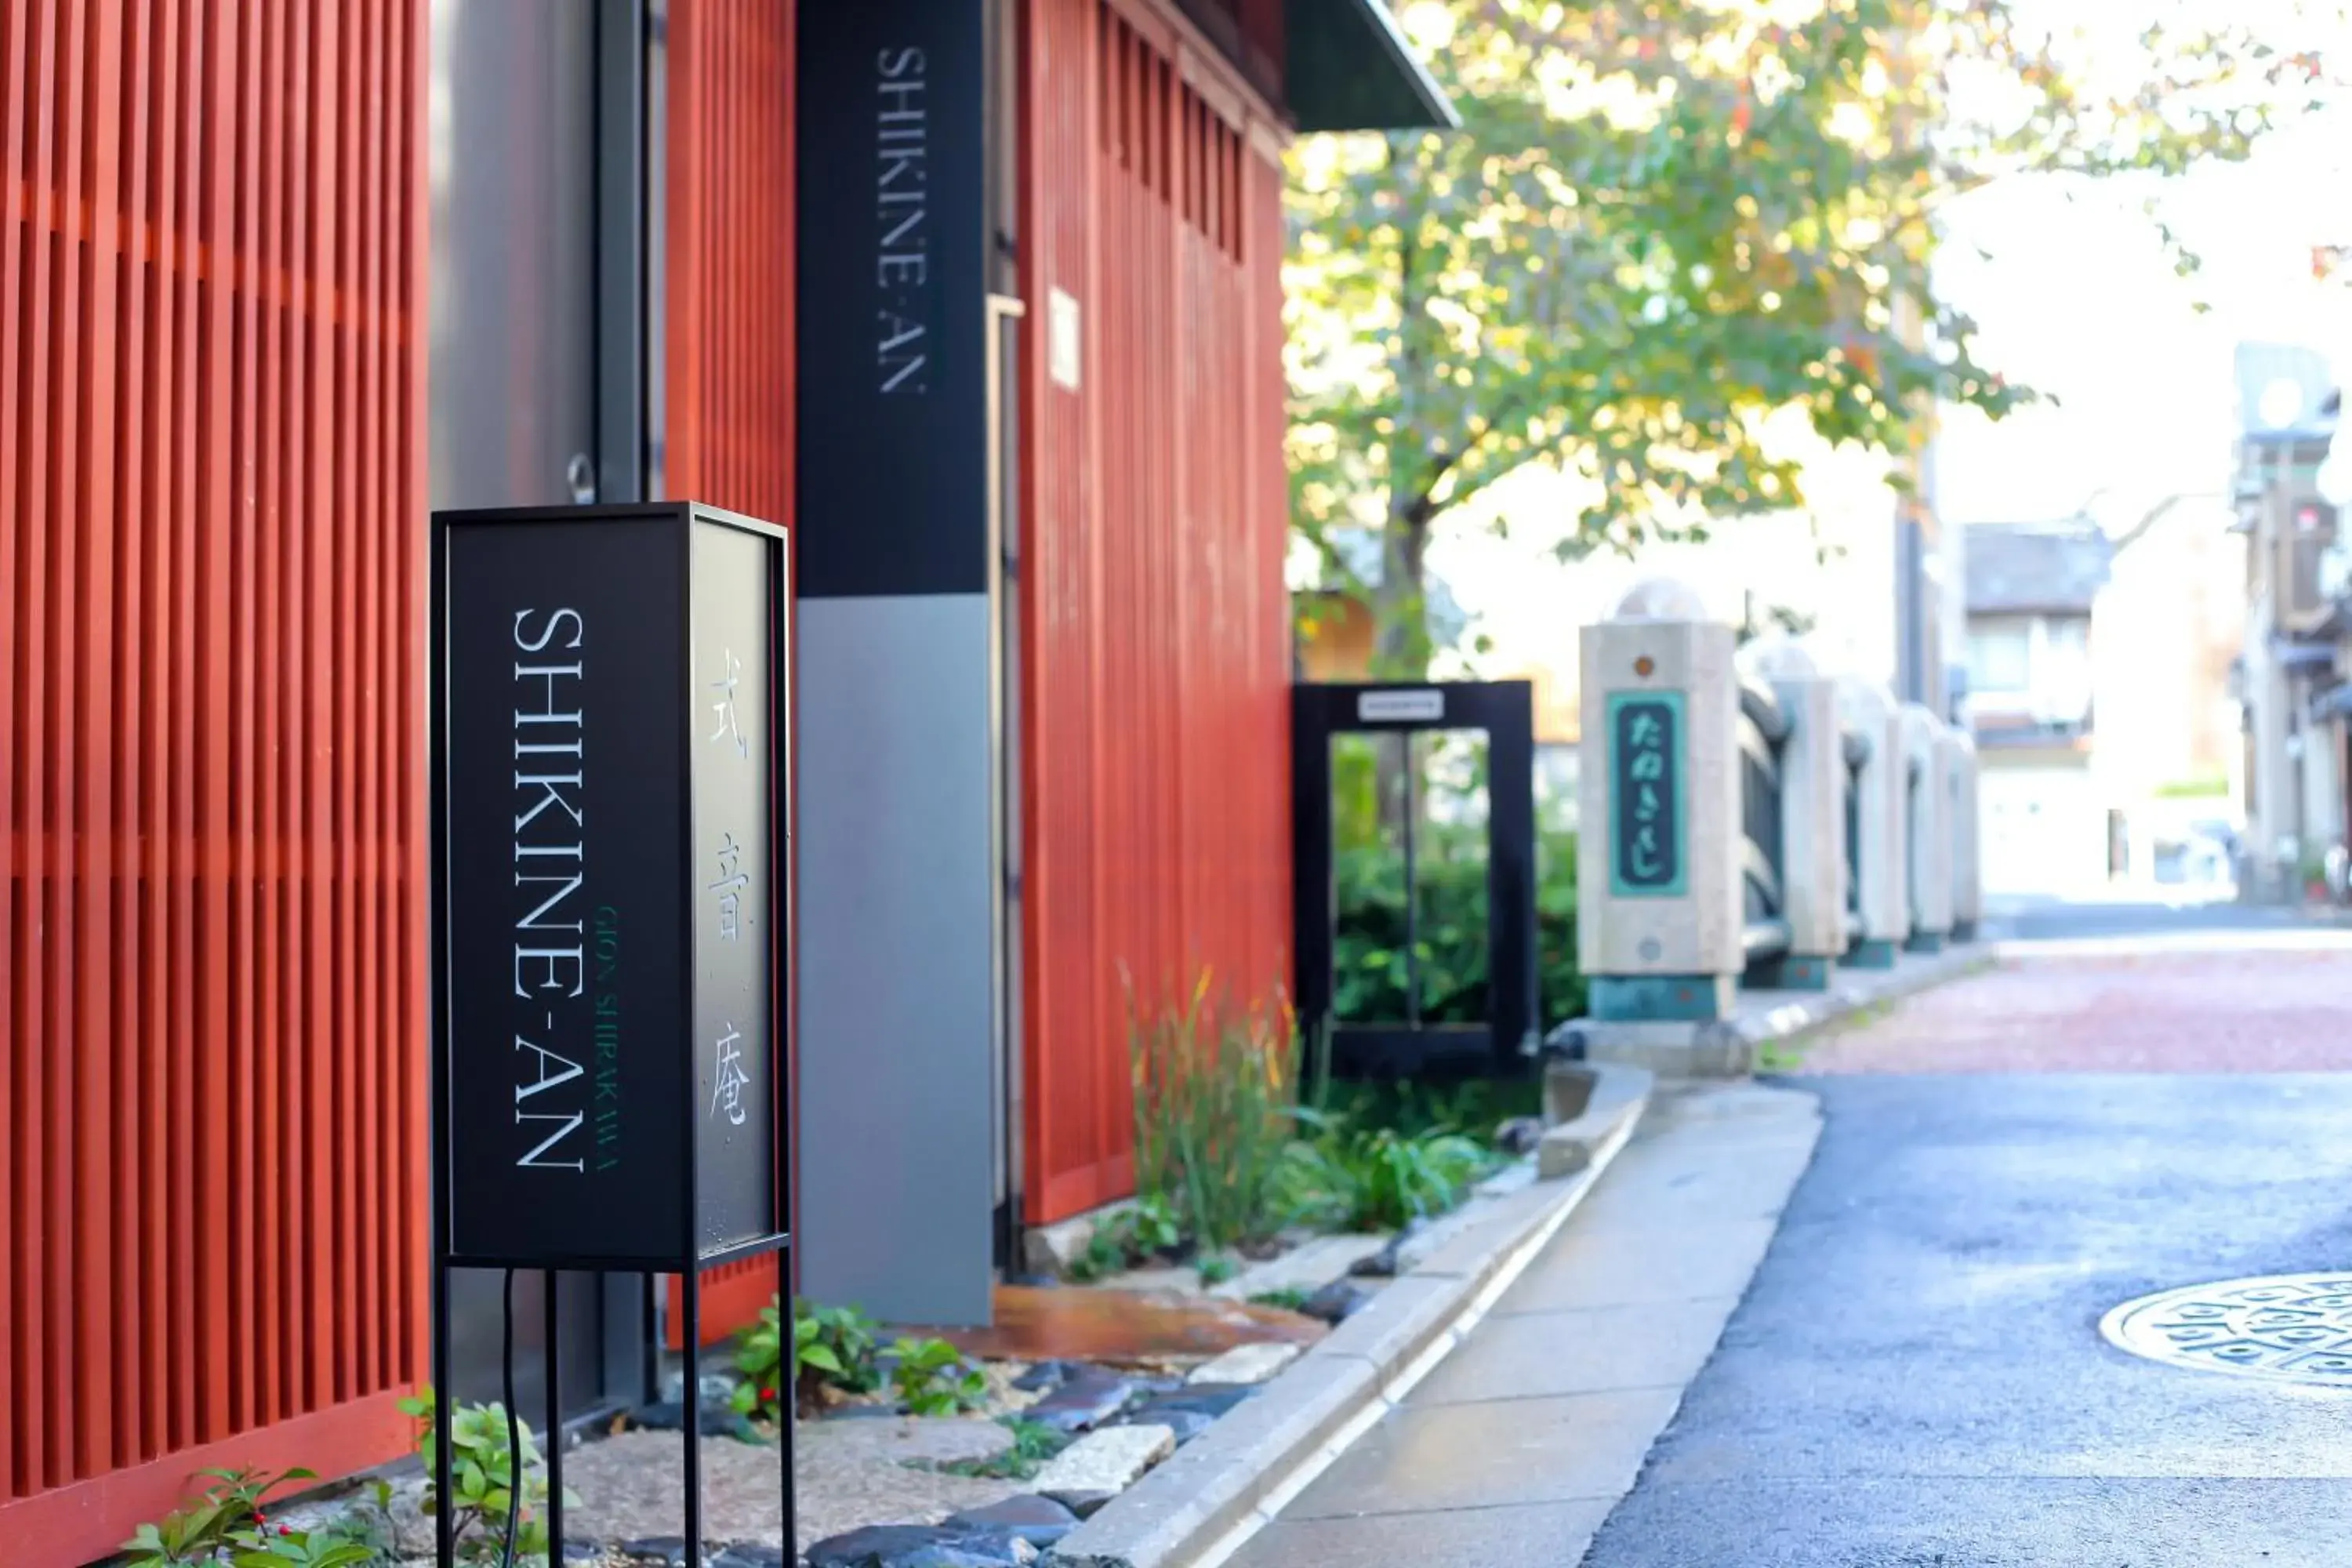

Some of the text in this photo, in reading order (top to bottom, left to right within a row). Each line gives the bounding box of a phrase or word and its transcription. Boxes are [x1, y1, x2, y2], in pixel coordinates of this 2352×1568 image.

[877, 46, 926, 394] SHIKINE-AN
[514, 607, 585, 1174] SHIKINE-AN
[593, 906, 620, 1173] GION SHIRAKAWA
[708, 648, 751, 1126] 式音庵
